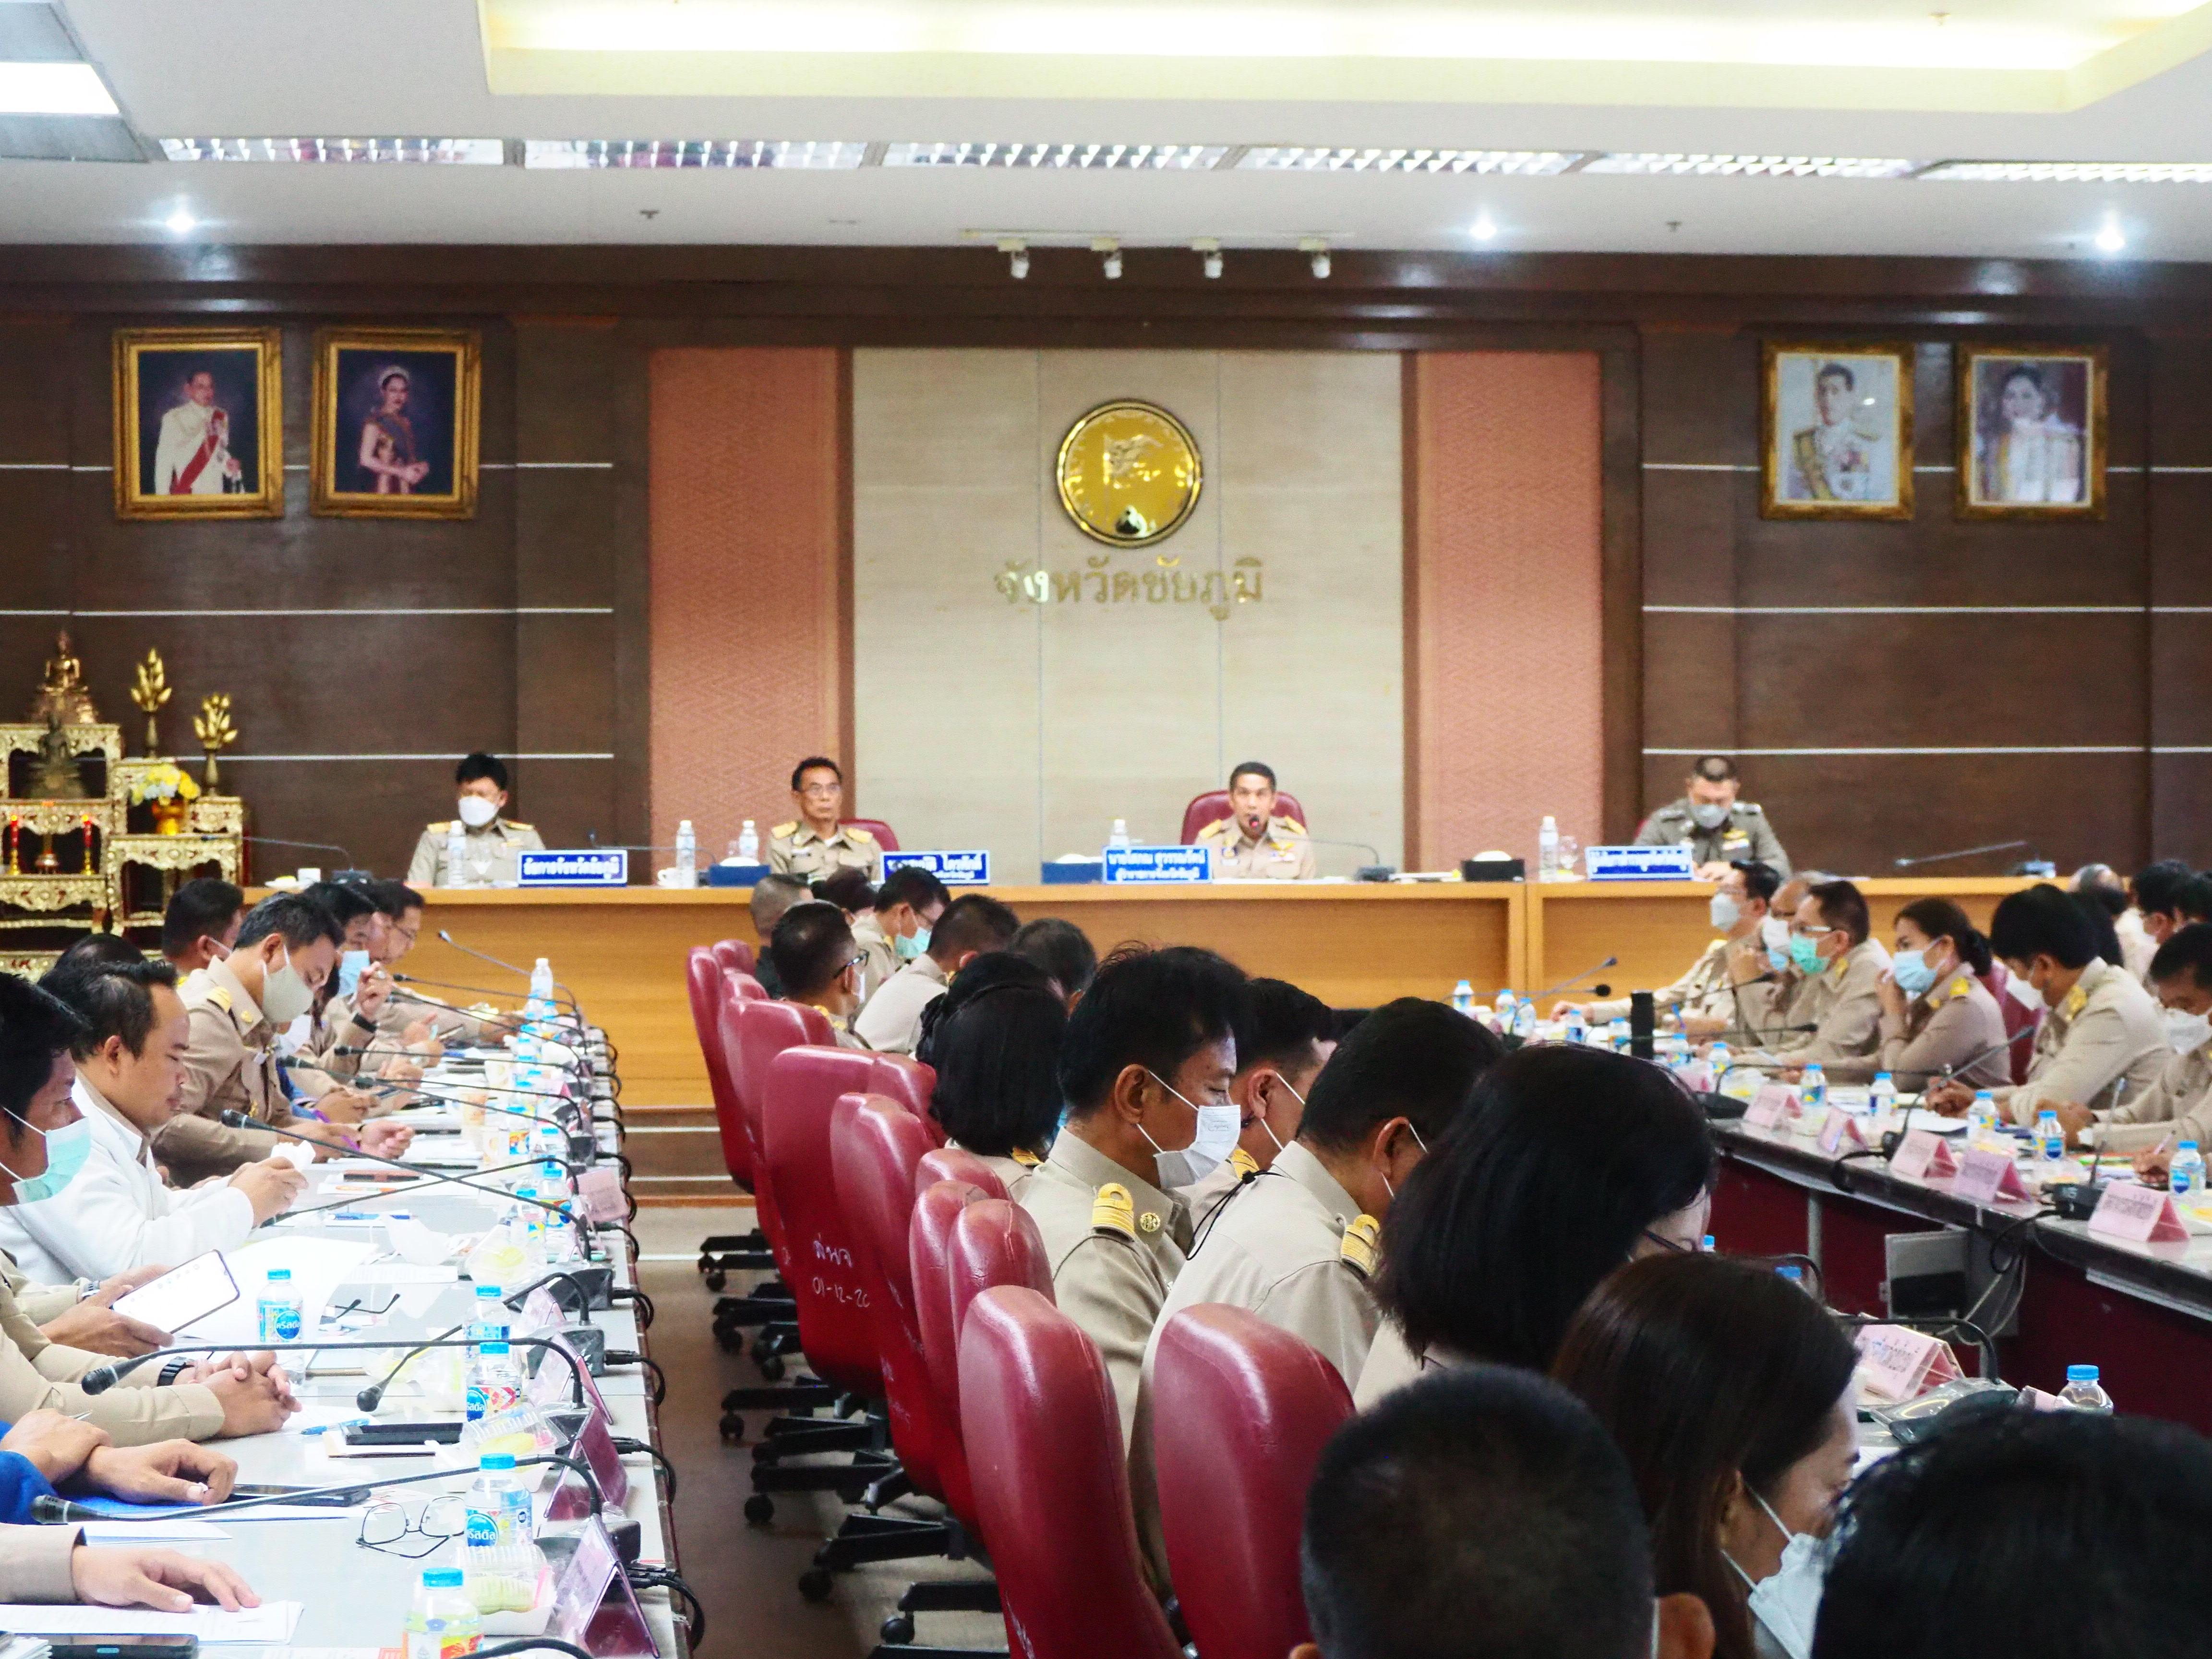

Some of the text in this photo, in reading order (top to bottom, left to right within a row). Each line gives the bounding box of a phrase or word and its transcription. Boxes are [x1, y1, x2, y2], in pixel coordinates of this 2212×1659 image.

[994, 554, 1263, 621] จังหวัดชัยภูมิ
